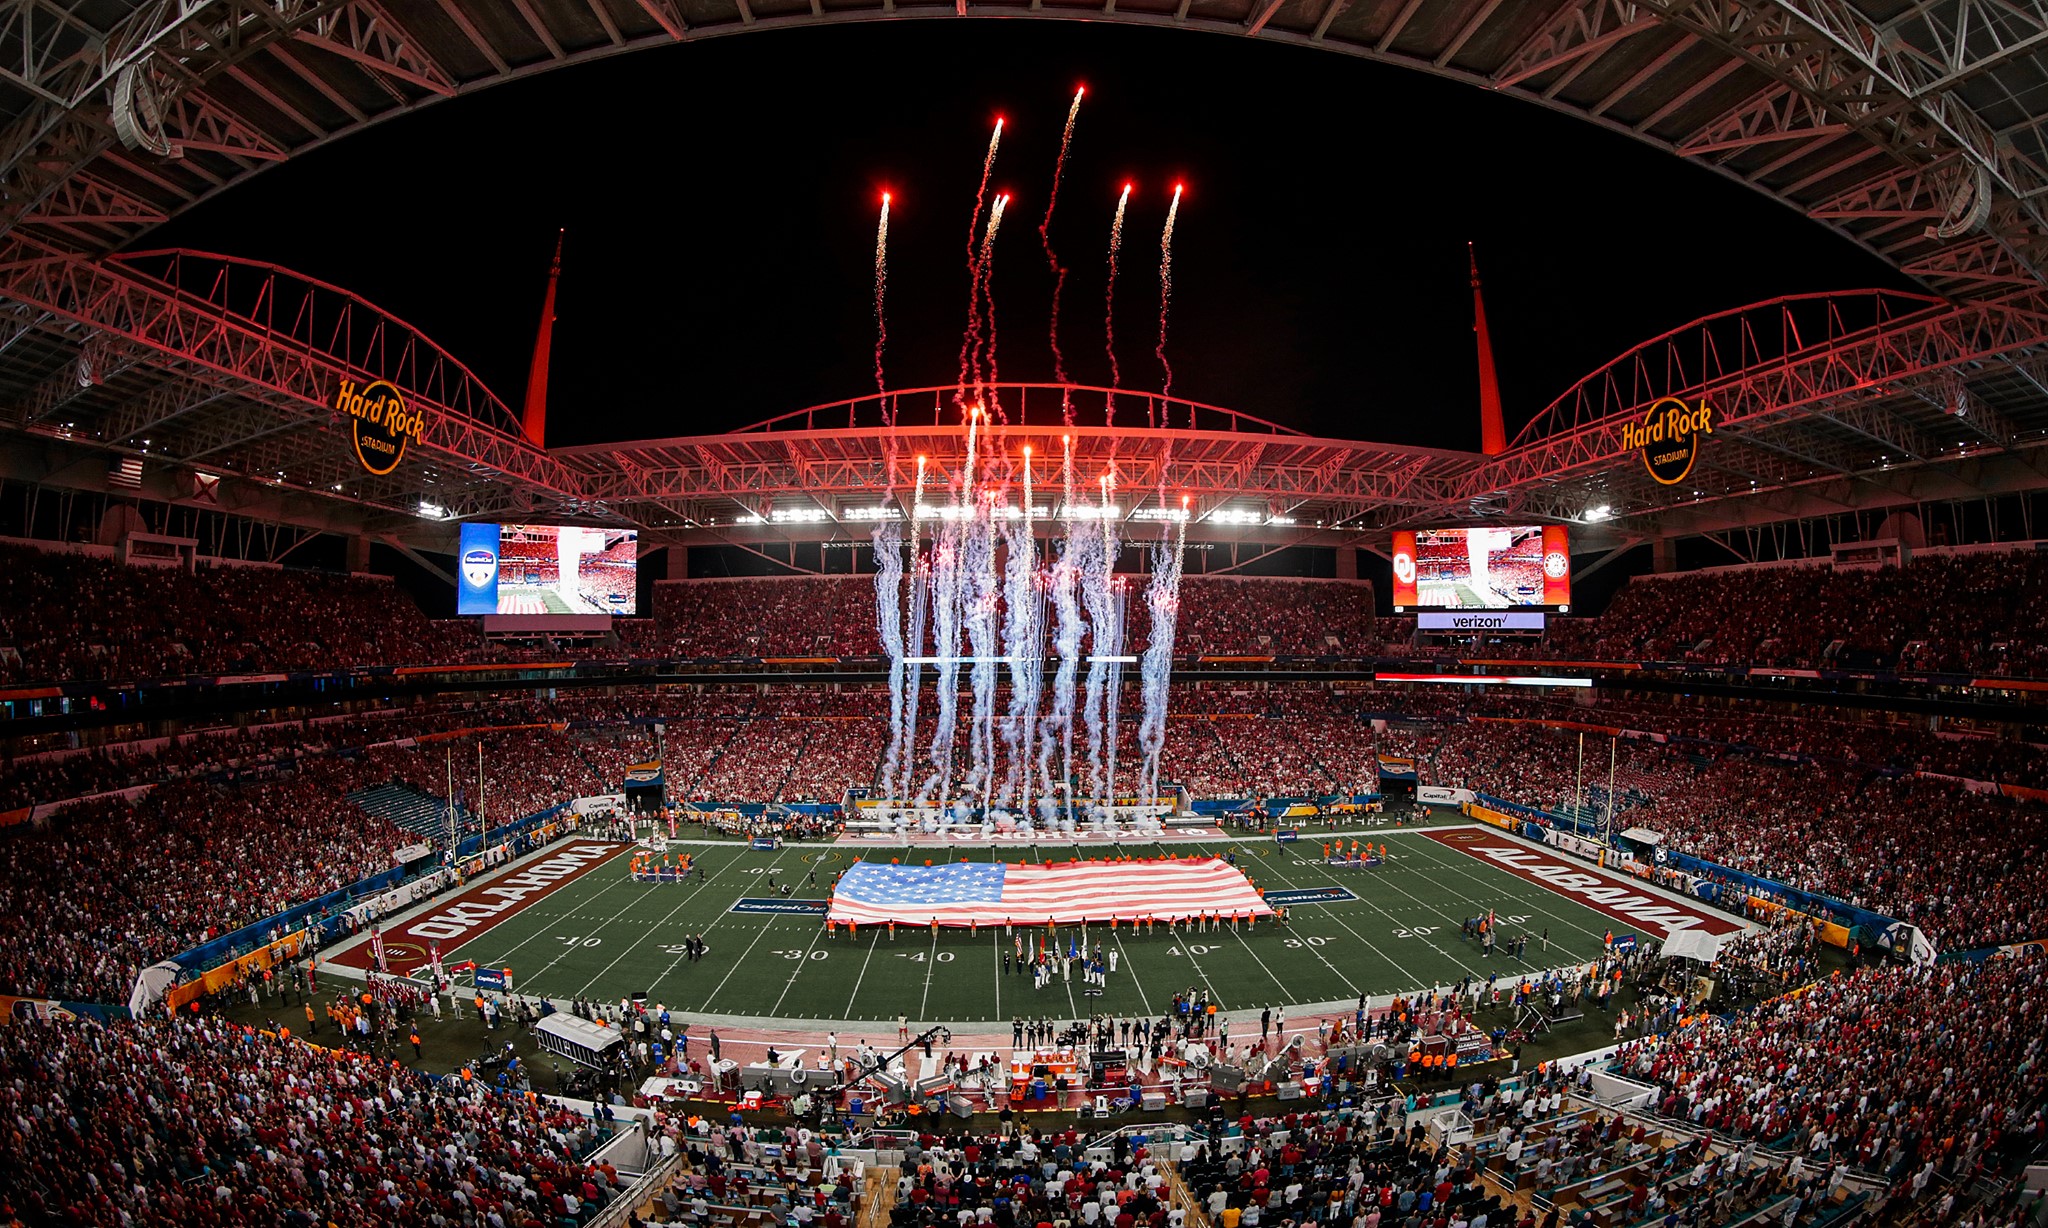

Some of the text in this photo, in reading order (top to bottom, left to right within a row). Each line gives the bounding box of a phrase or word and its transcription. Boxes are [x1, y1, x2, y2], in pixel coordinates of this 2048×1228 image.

[336, 380, 425, 446] Hard Rock
[1622, 399, 1713, 451] Hard Rock
[361, 436, 396, 455] STADIUM
[1653, 449, 1689, 466] STADIUM
[1453, 615, 1502, 628] verizon
[407, 844, 620, 940] OKLAHOMA
[1468, 846, 1705, 931] ALABAMA
[1391, 925, 1433, 939] 20
[562, 936, 602, 948] 10
[1284, 936, 1327, 950] 30
[783, 949, 829, 961] 30
[909, 951, 956, 963] 40
[1165, 945, 1209, 956] 40
